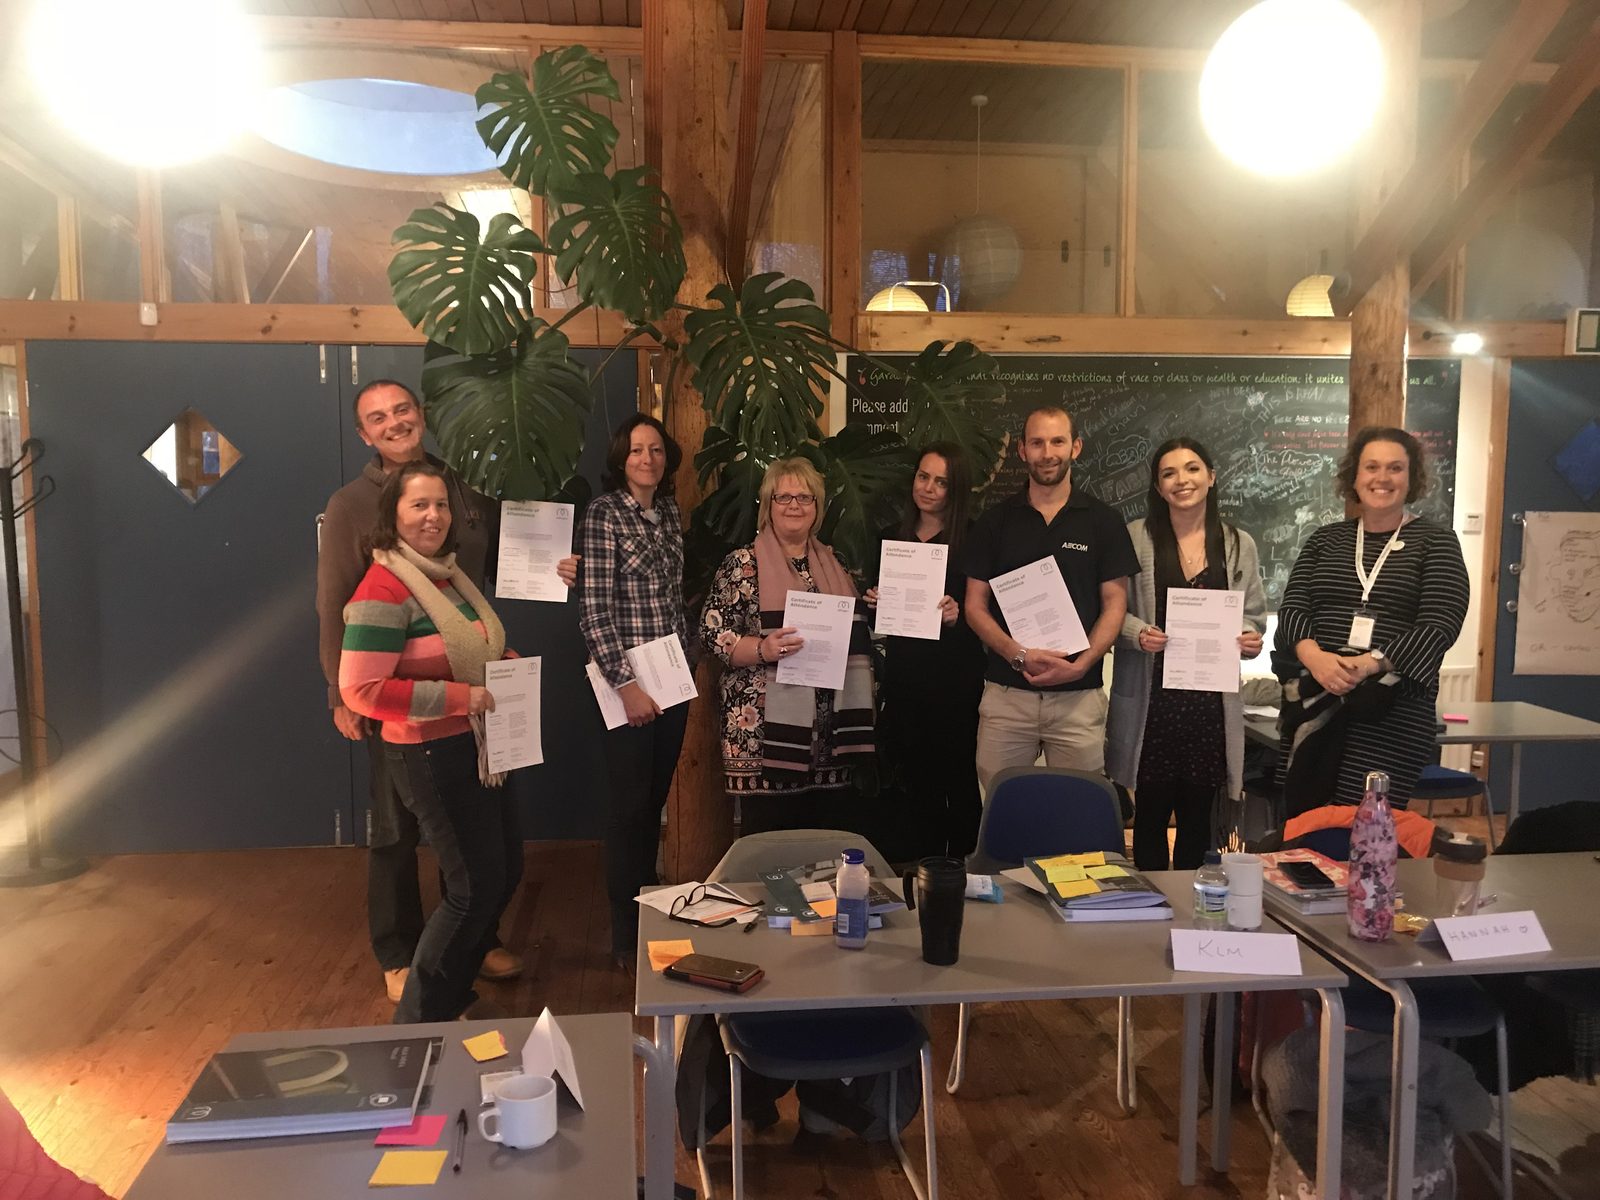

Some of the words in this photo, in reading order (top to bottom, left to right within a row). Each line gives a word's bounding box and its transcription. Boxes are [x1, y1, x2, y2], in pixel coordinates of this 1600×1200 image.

[991, 371, 1039, 385] recognises
[1042, 373, 1054, 381] no
[1057, 372, 1112, 383] restrictions
[1116, 371, 1126, 385] of
[1130, 374, 1149, 382] race
[1153, 374, 1164, 382] or
[1166, 372, 1189, 382] class
[1192, 374, 1203, 382] or
[1239, 374, 1252, 382] or
[1305, 372, 1313, 383] it
[1316, 373, 1344, 384] unites
[1409, 377, 1420, 385] us
[852, 398, 886, 413] Please
[889, 398, 908, 413] add
[1061, 541, 1088, 552] AECOM
[1447, 925, 1511, 942] HANNAH
